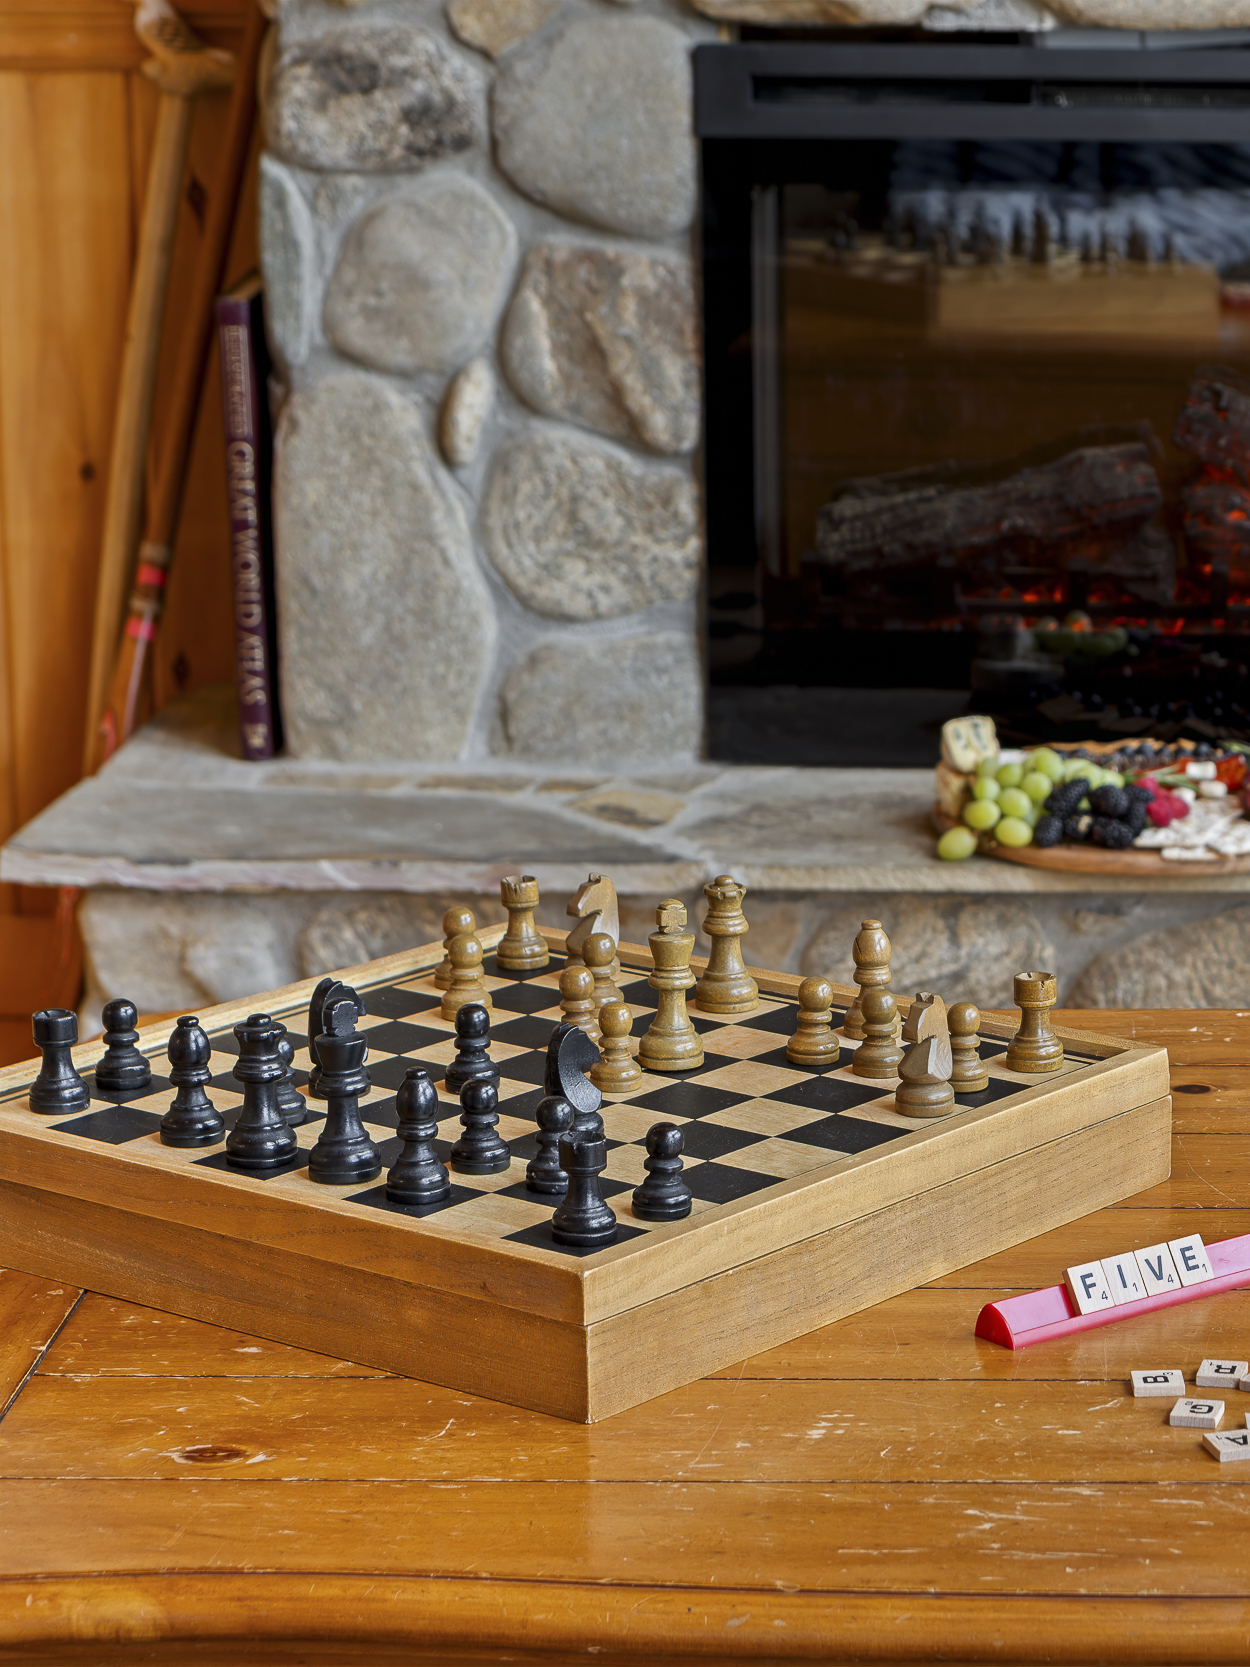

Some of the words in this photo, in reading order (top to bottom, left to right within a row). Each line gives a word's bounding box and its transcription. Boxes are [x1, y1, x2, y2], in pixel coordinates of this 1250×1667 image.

[227, 440, 257, 527] GREAT
[232, 528, 262, 629] WORLD
[237, 630, 267, 706] ATLAS
[1080, 1245, 1200, 1299] FIVE
